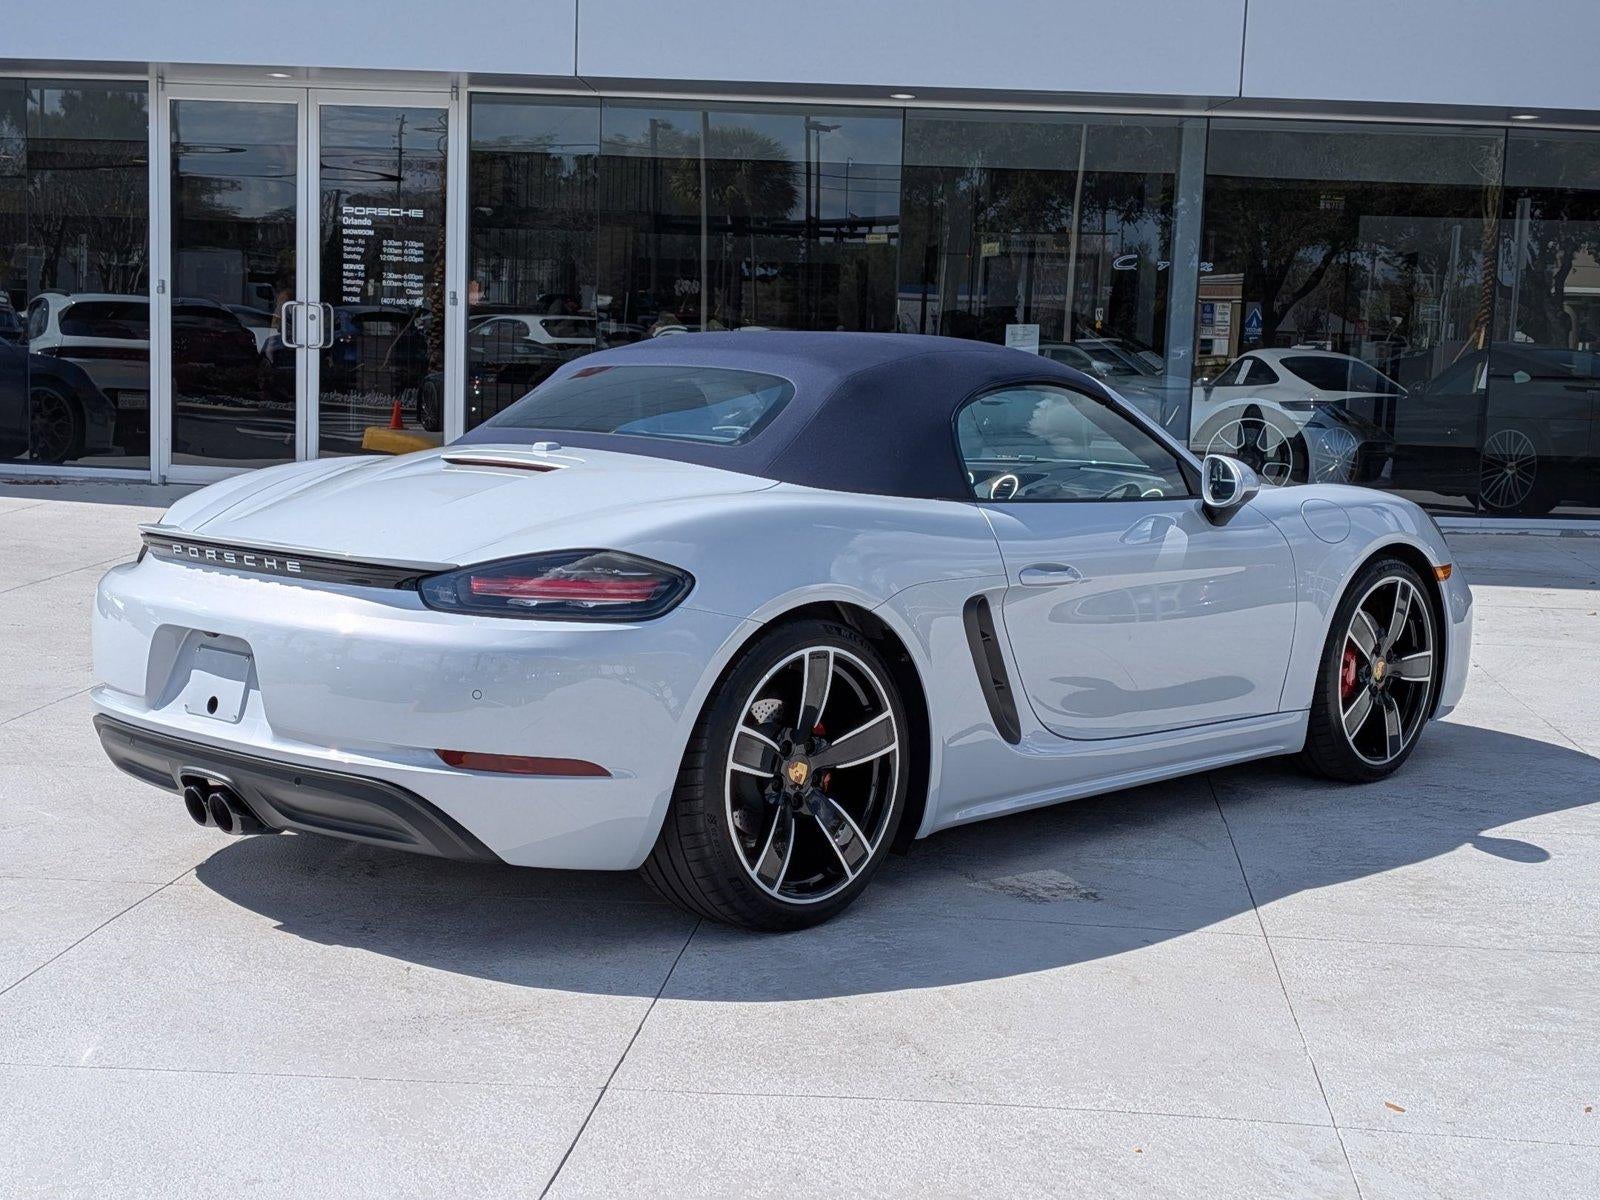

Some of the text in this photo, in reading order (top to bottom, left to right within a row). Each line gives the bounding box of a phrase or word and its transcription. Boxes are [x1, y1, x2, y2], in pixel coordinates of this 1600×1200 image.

[342, 206, 424, 217] PORSCHE
[342, 216, 372, 226] Orlando
[342, 228, 375, 236] SHOWROOM
[343, 245, 365, 253] Saturday
[342, 263, 366, 271] SERVICE
[342, 278, 365, 286] Saturday
[405, 288, 424, 296] Closed
[342, 295, 361, 303] PHONE
[172, 544, 301, 573] PORSCHE
